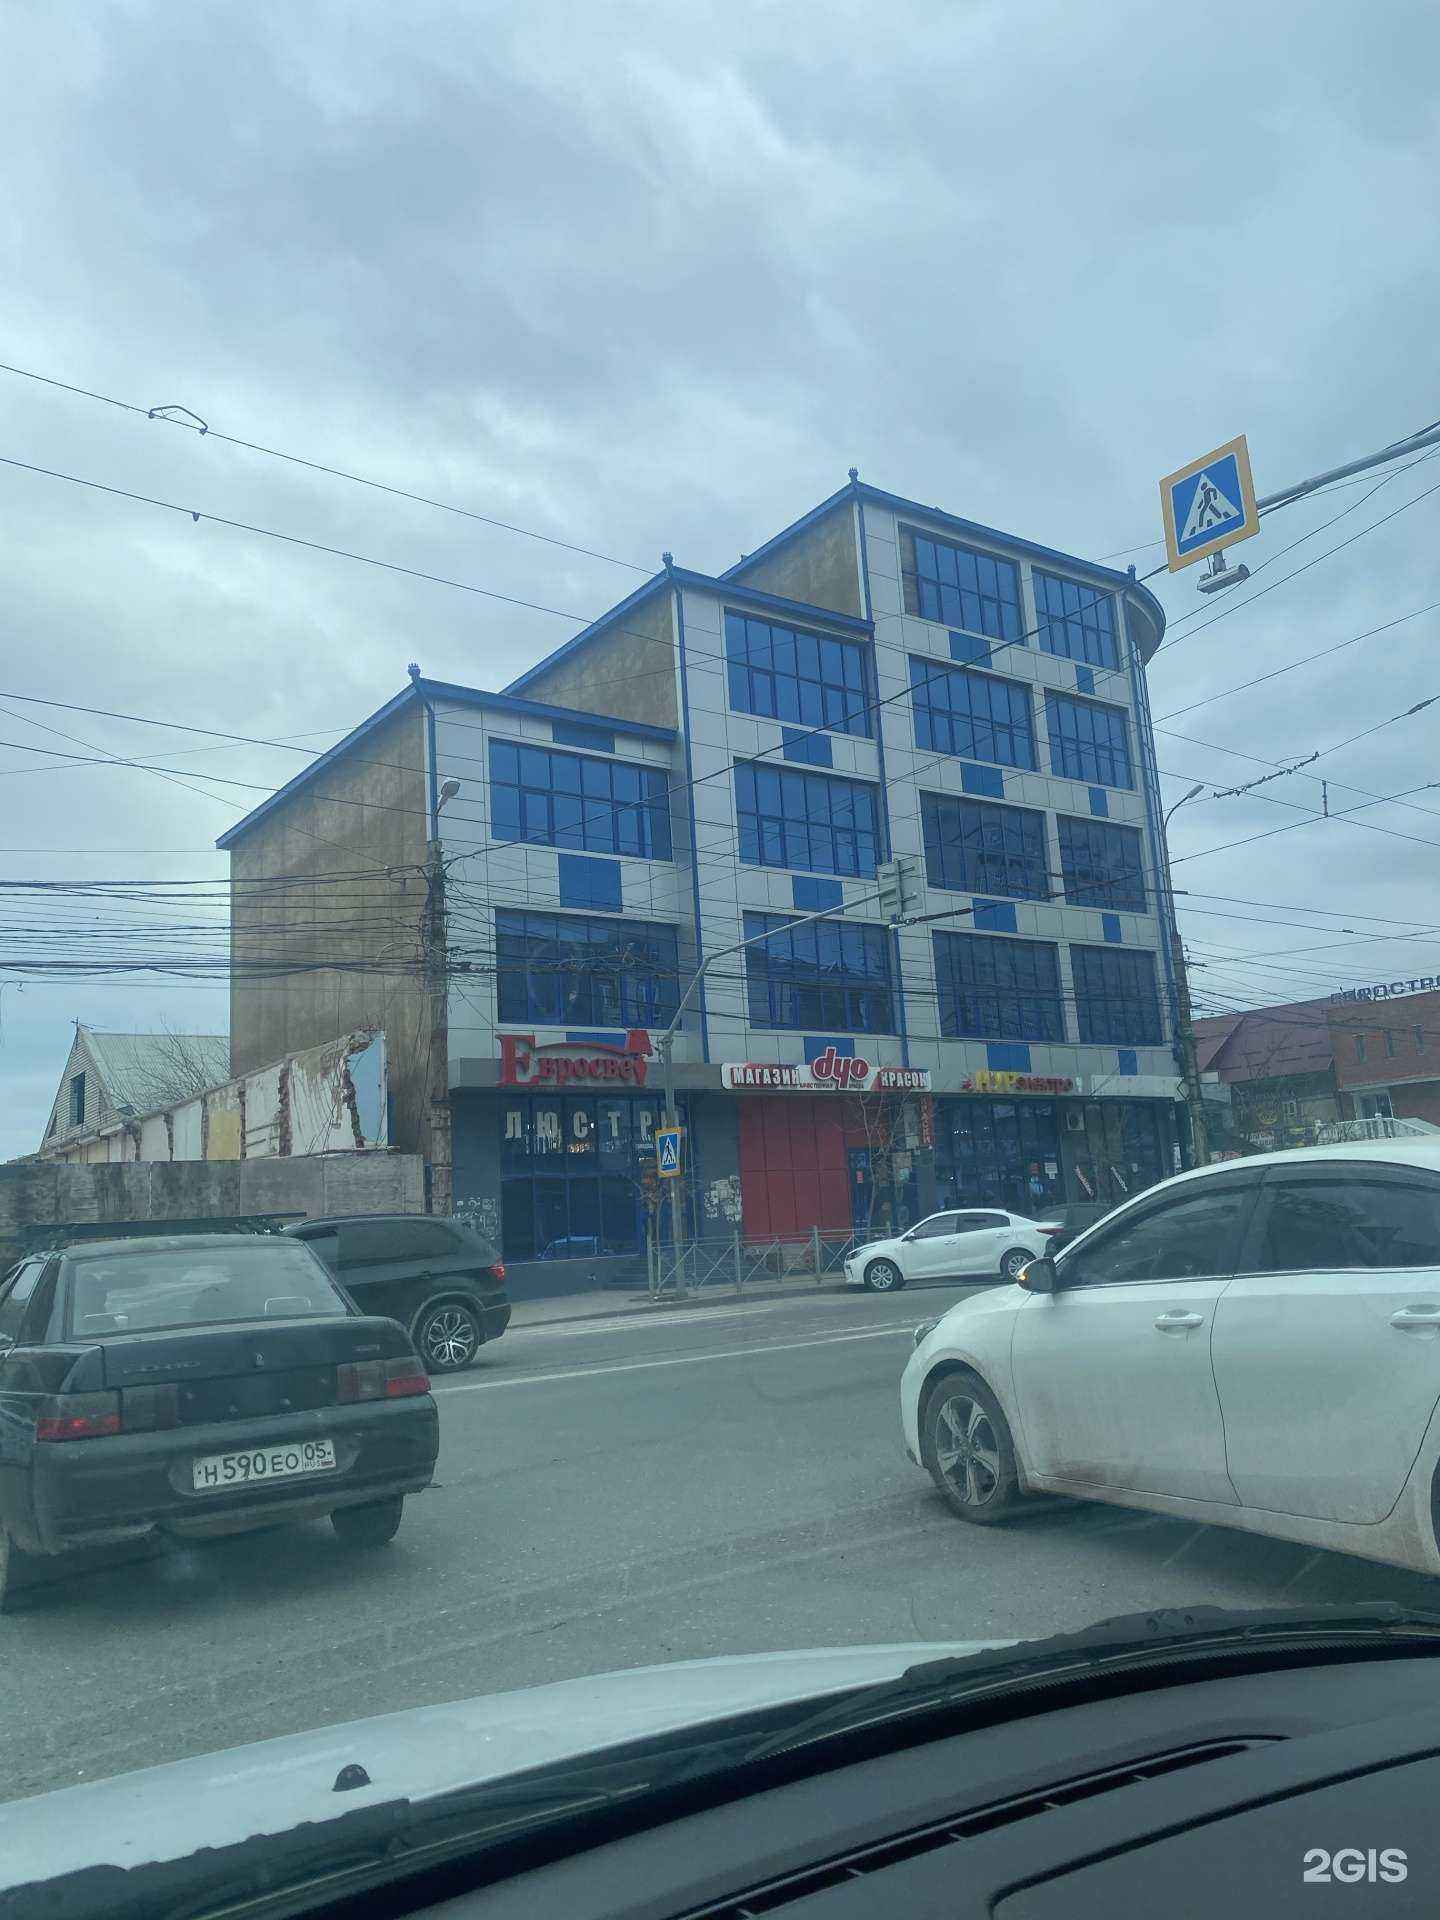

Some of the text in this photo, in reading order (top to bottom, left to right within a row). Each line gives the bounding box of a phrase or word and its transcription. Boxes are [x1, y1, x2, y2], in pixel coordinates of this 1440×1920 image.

[732, 1067, 801, 1086] МАГАЗИН
[880, 1071, 930, 1088] КРАСОК
[304, 1442, 327, 1461] 05
